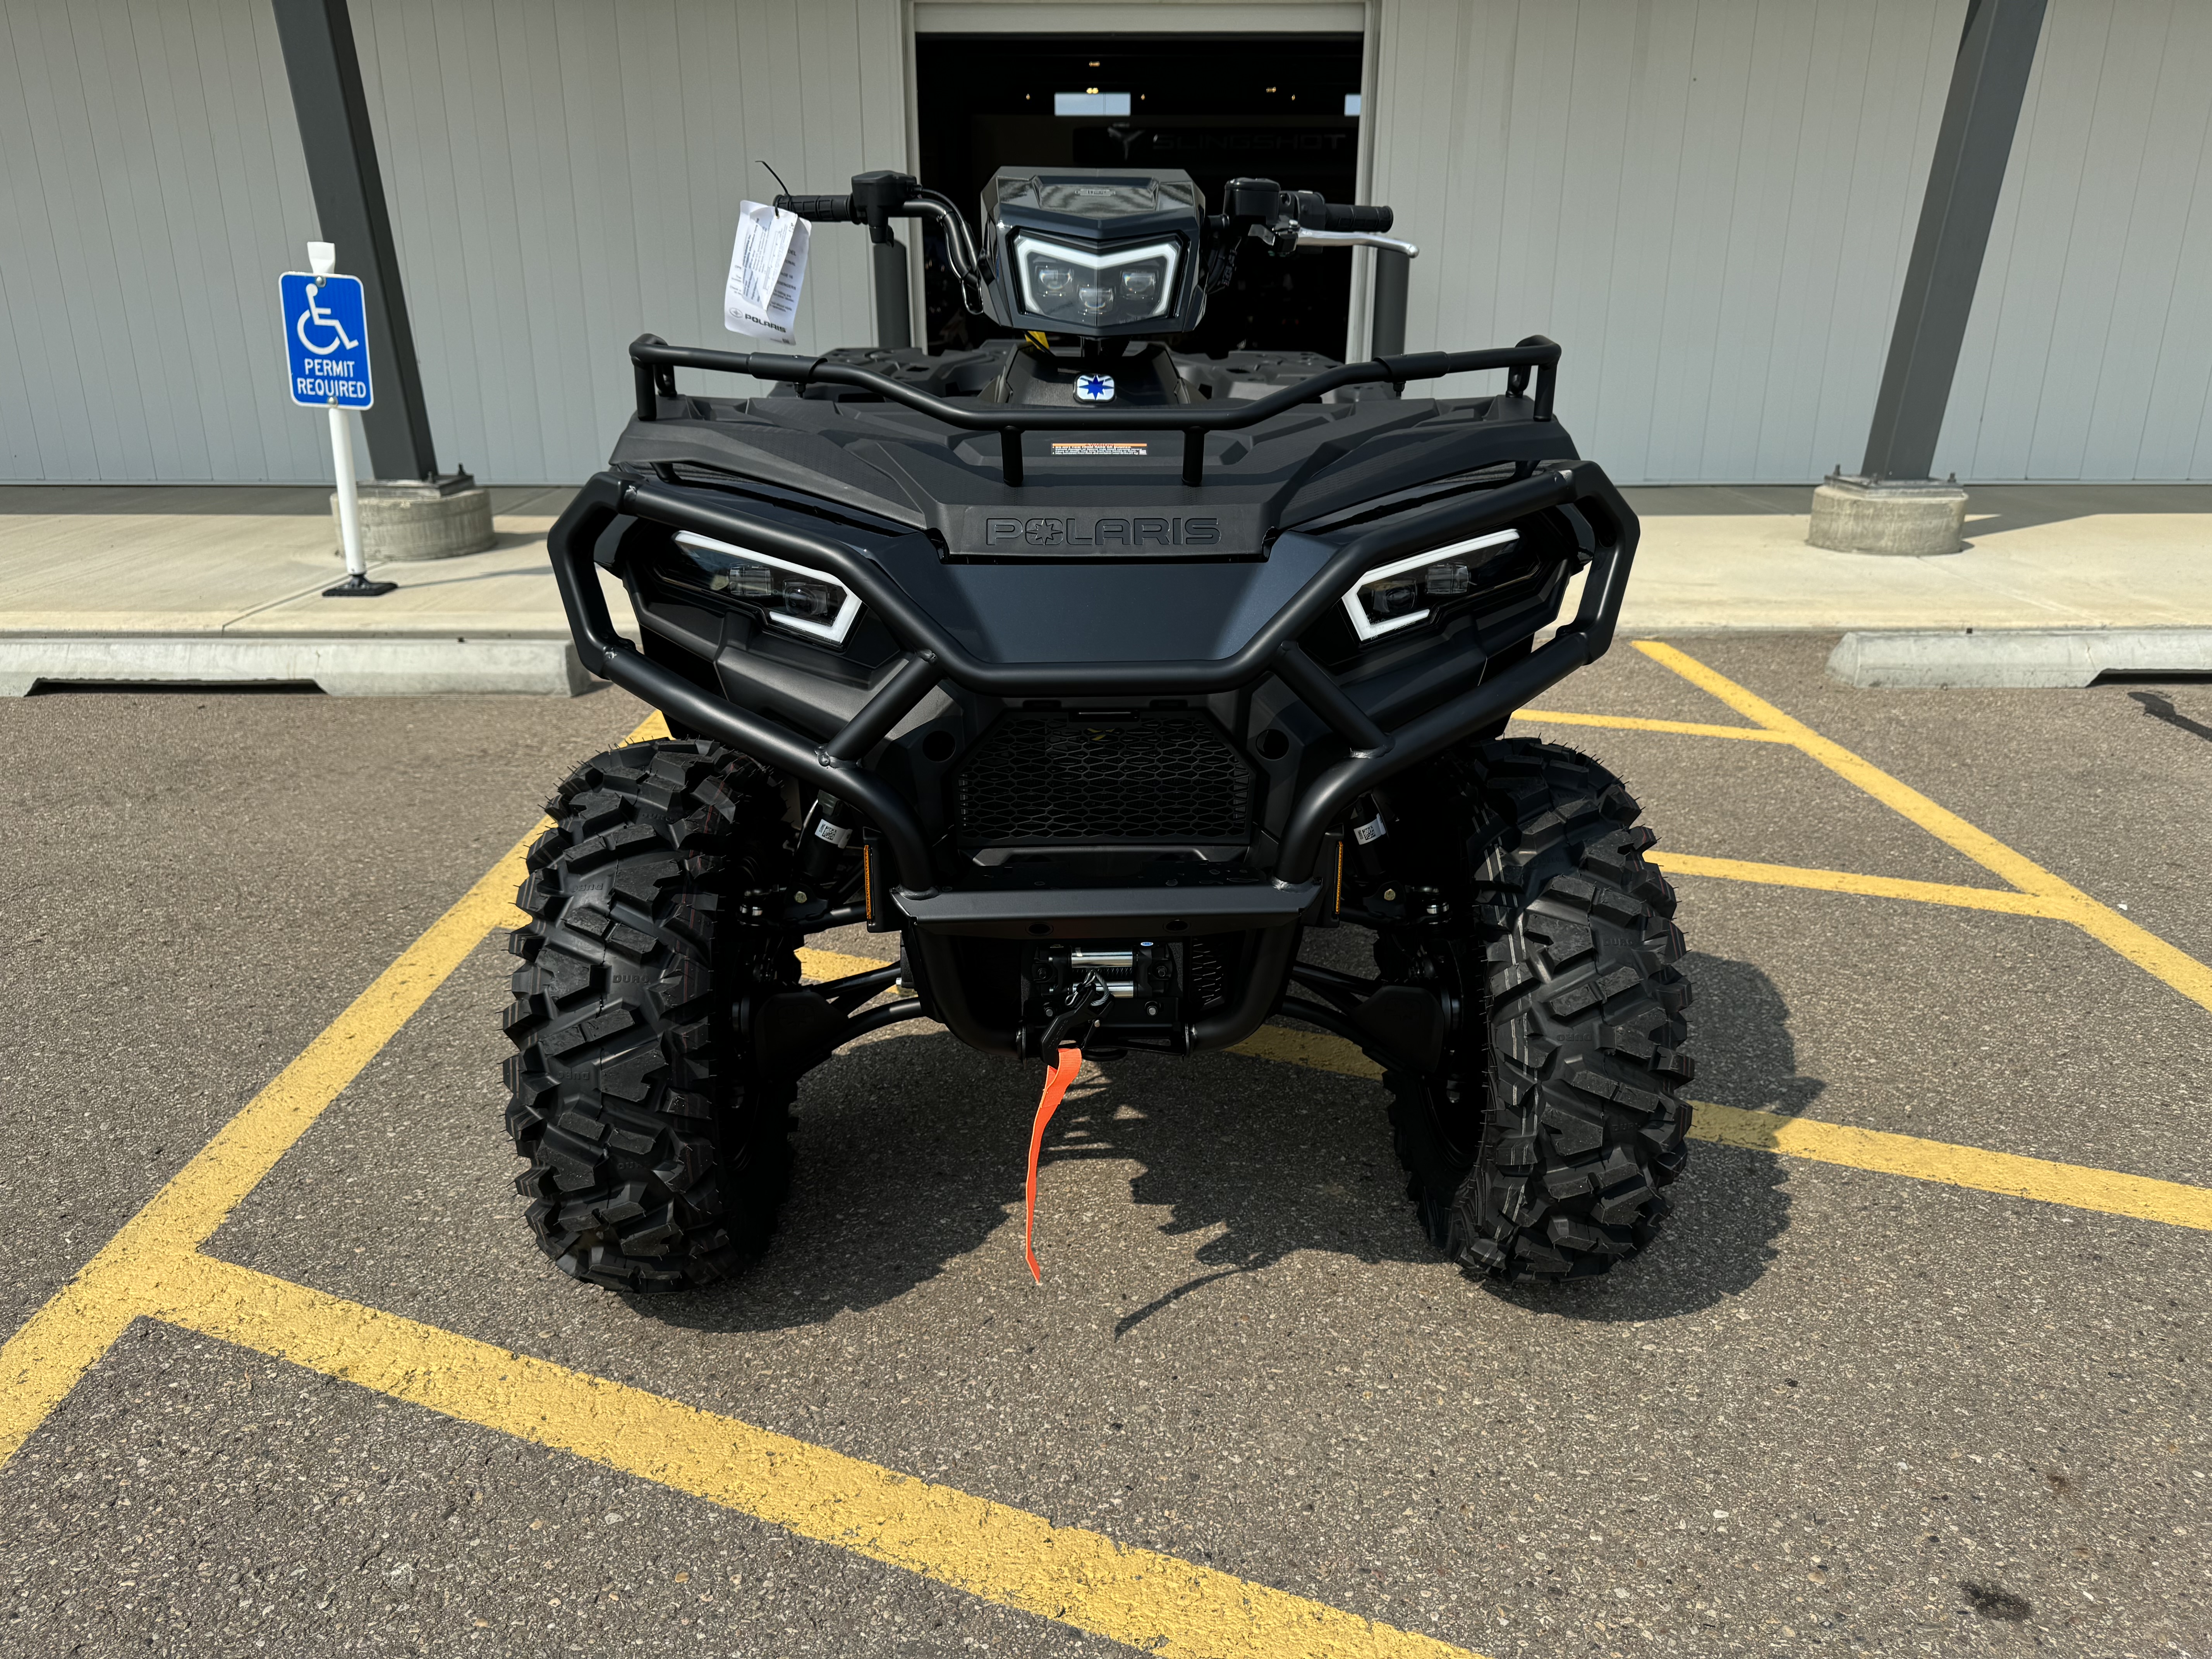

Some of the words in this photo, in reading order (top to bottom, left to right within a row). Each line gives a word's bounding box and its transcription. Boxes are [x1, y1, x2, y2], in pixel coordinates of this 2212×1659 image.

[1152, 134, 1346, 149] SLINGSHOT
[745, 313, 786, 333] POLARIS
[304, 358, 354, 378] PERMIT
[297, 378, 366, 398] REQUIRED
[986, 518, 1222, 546] POLARIS
[1603, 938, 1633, 946] DURO
[613, 975, 649, 983] DURO
[1557, 1033, 1592, 1041] DURO
[558, 1071, 589, 1080] DURO
